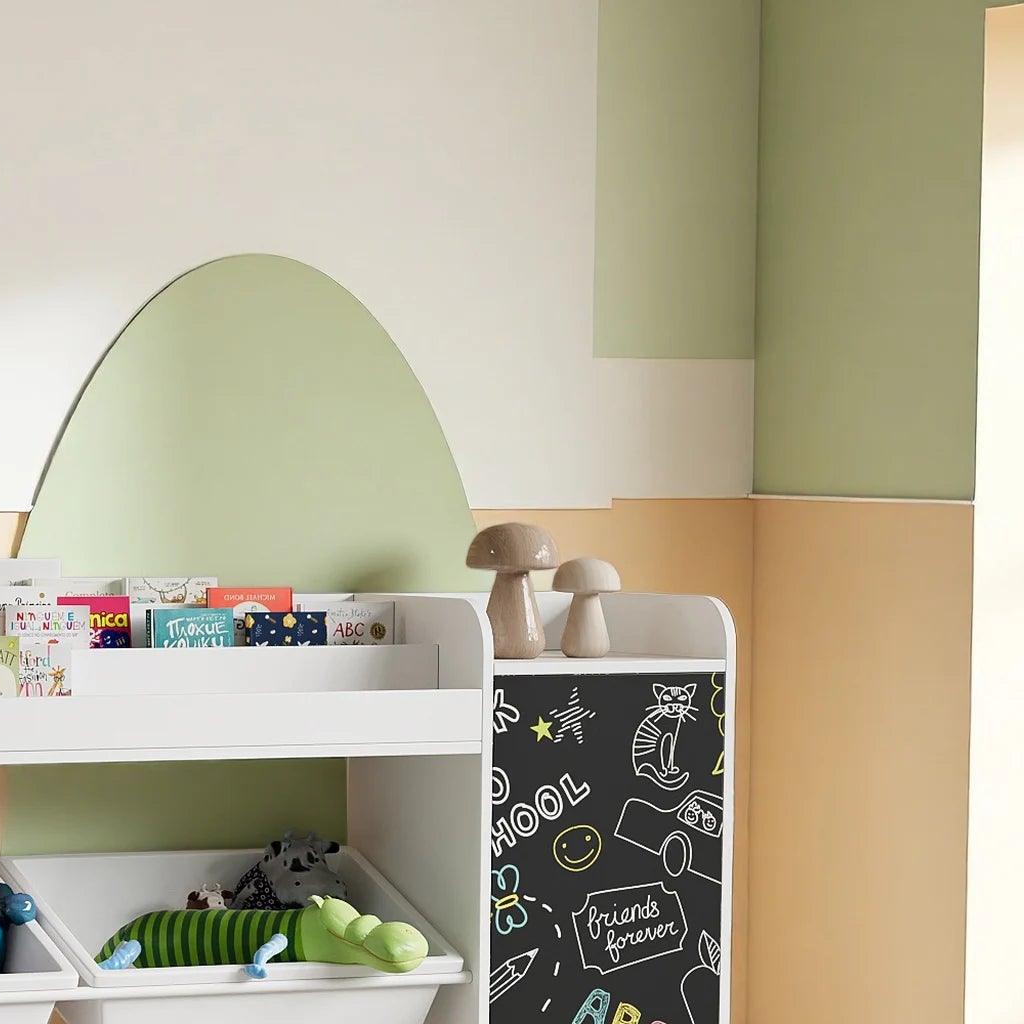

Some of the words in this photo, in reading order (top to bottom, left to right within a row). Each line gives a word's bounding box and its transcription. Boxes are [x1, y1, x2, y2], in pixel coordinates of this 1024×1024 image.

[332, 621, 365, 638] ABC
[587, 894, 660, 940] friends
[605, 921, 679, 964] forever
